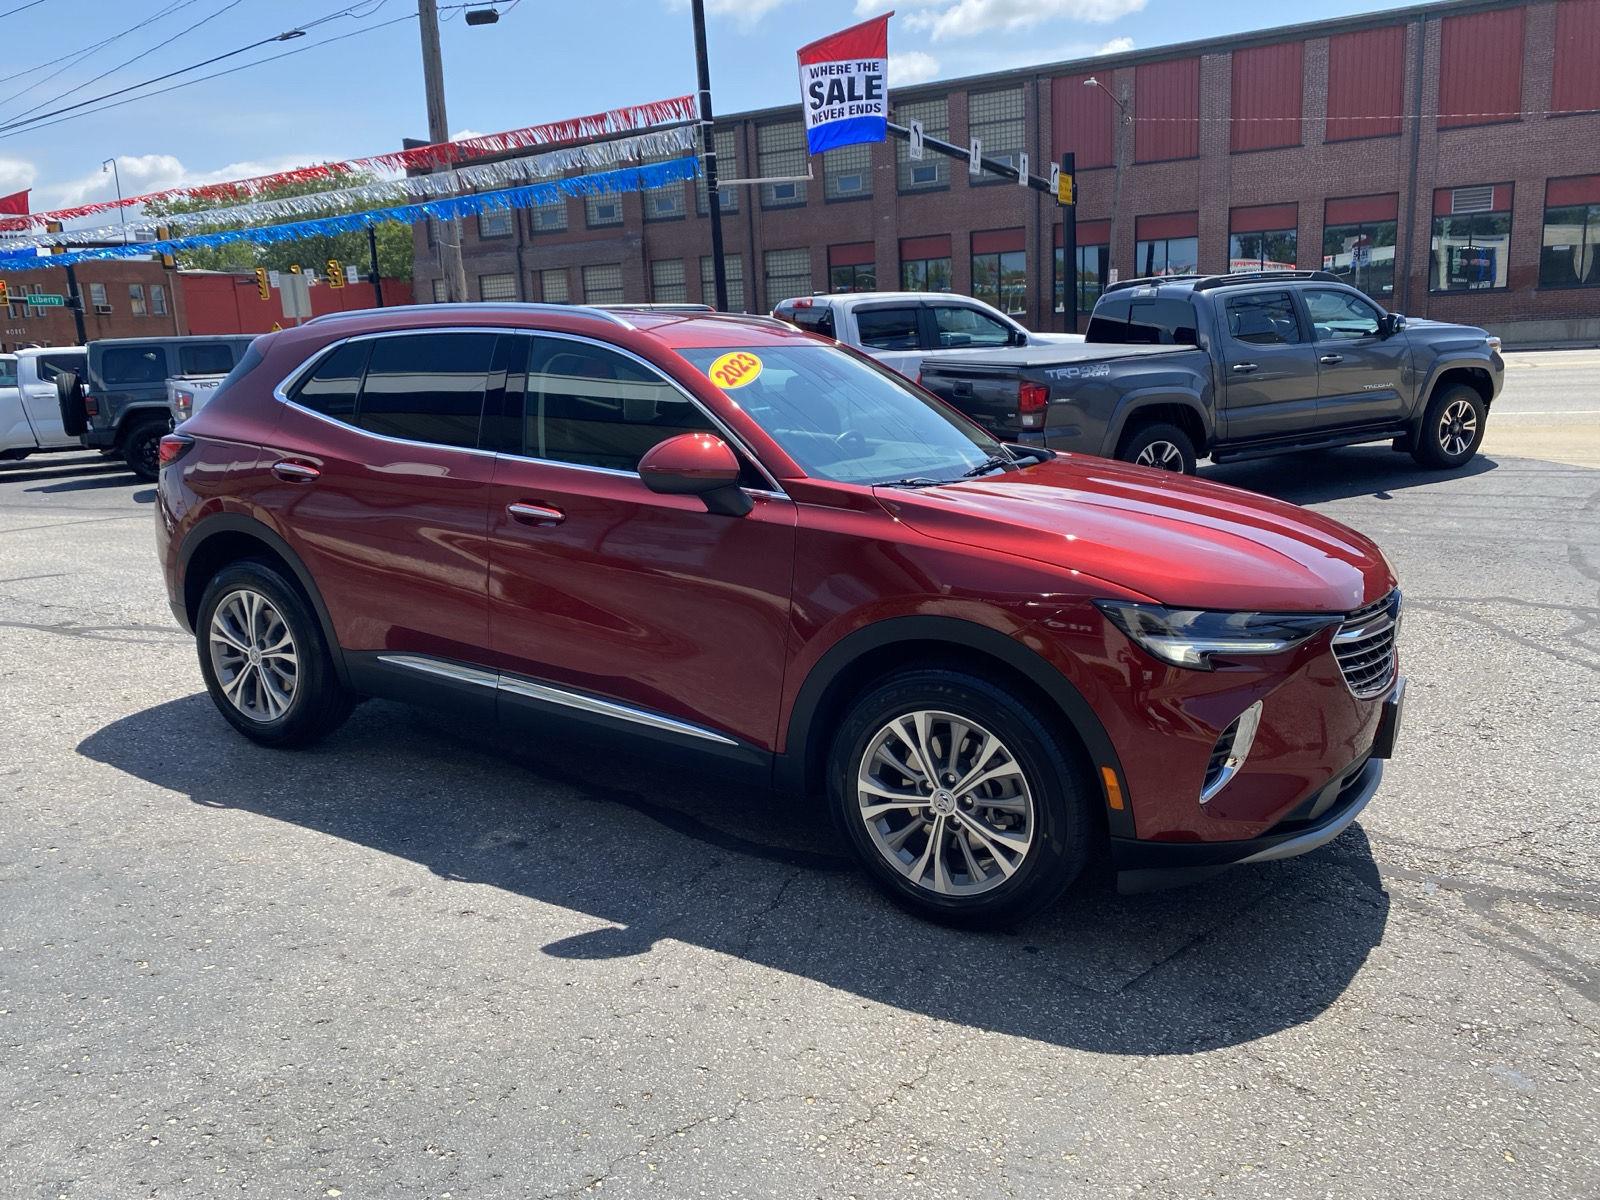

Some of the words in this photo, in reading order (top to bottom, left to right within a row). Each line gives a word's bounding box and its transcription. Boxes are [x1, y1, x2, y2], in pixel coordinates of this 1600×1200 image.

[809, 63, 852, 79] WHERE
[856, 62, 880, 73] THE
[809, 74, 883, 110] SALE
[811, 107, 845, 125] NEVER
[848, 102, 882, 116] ENDS
[31, 296, 60, 304] Liberty
[715, 353, 757, 386] 2023
[1044, 367, 1080, 380] TRD
[190, 381, 220, 389] TRD
